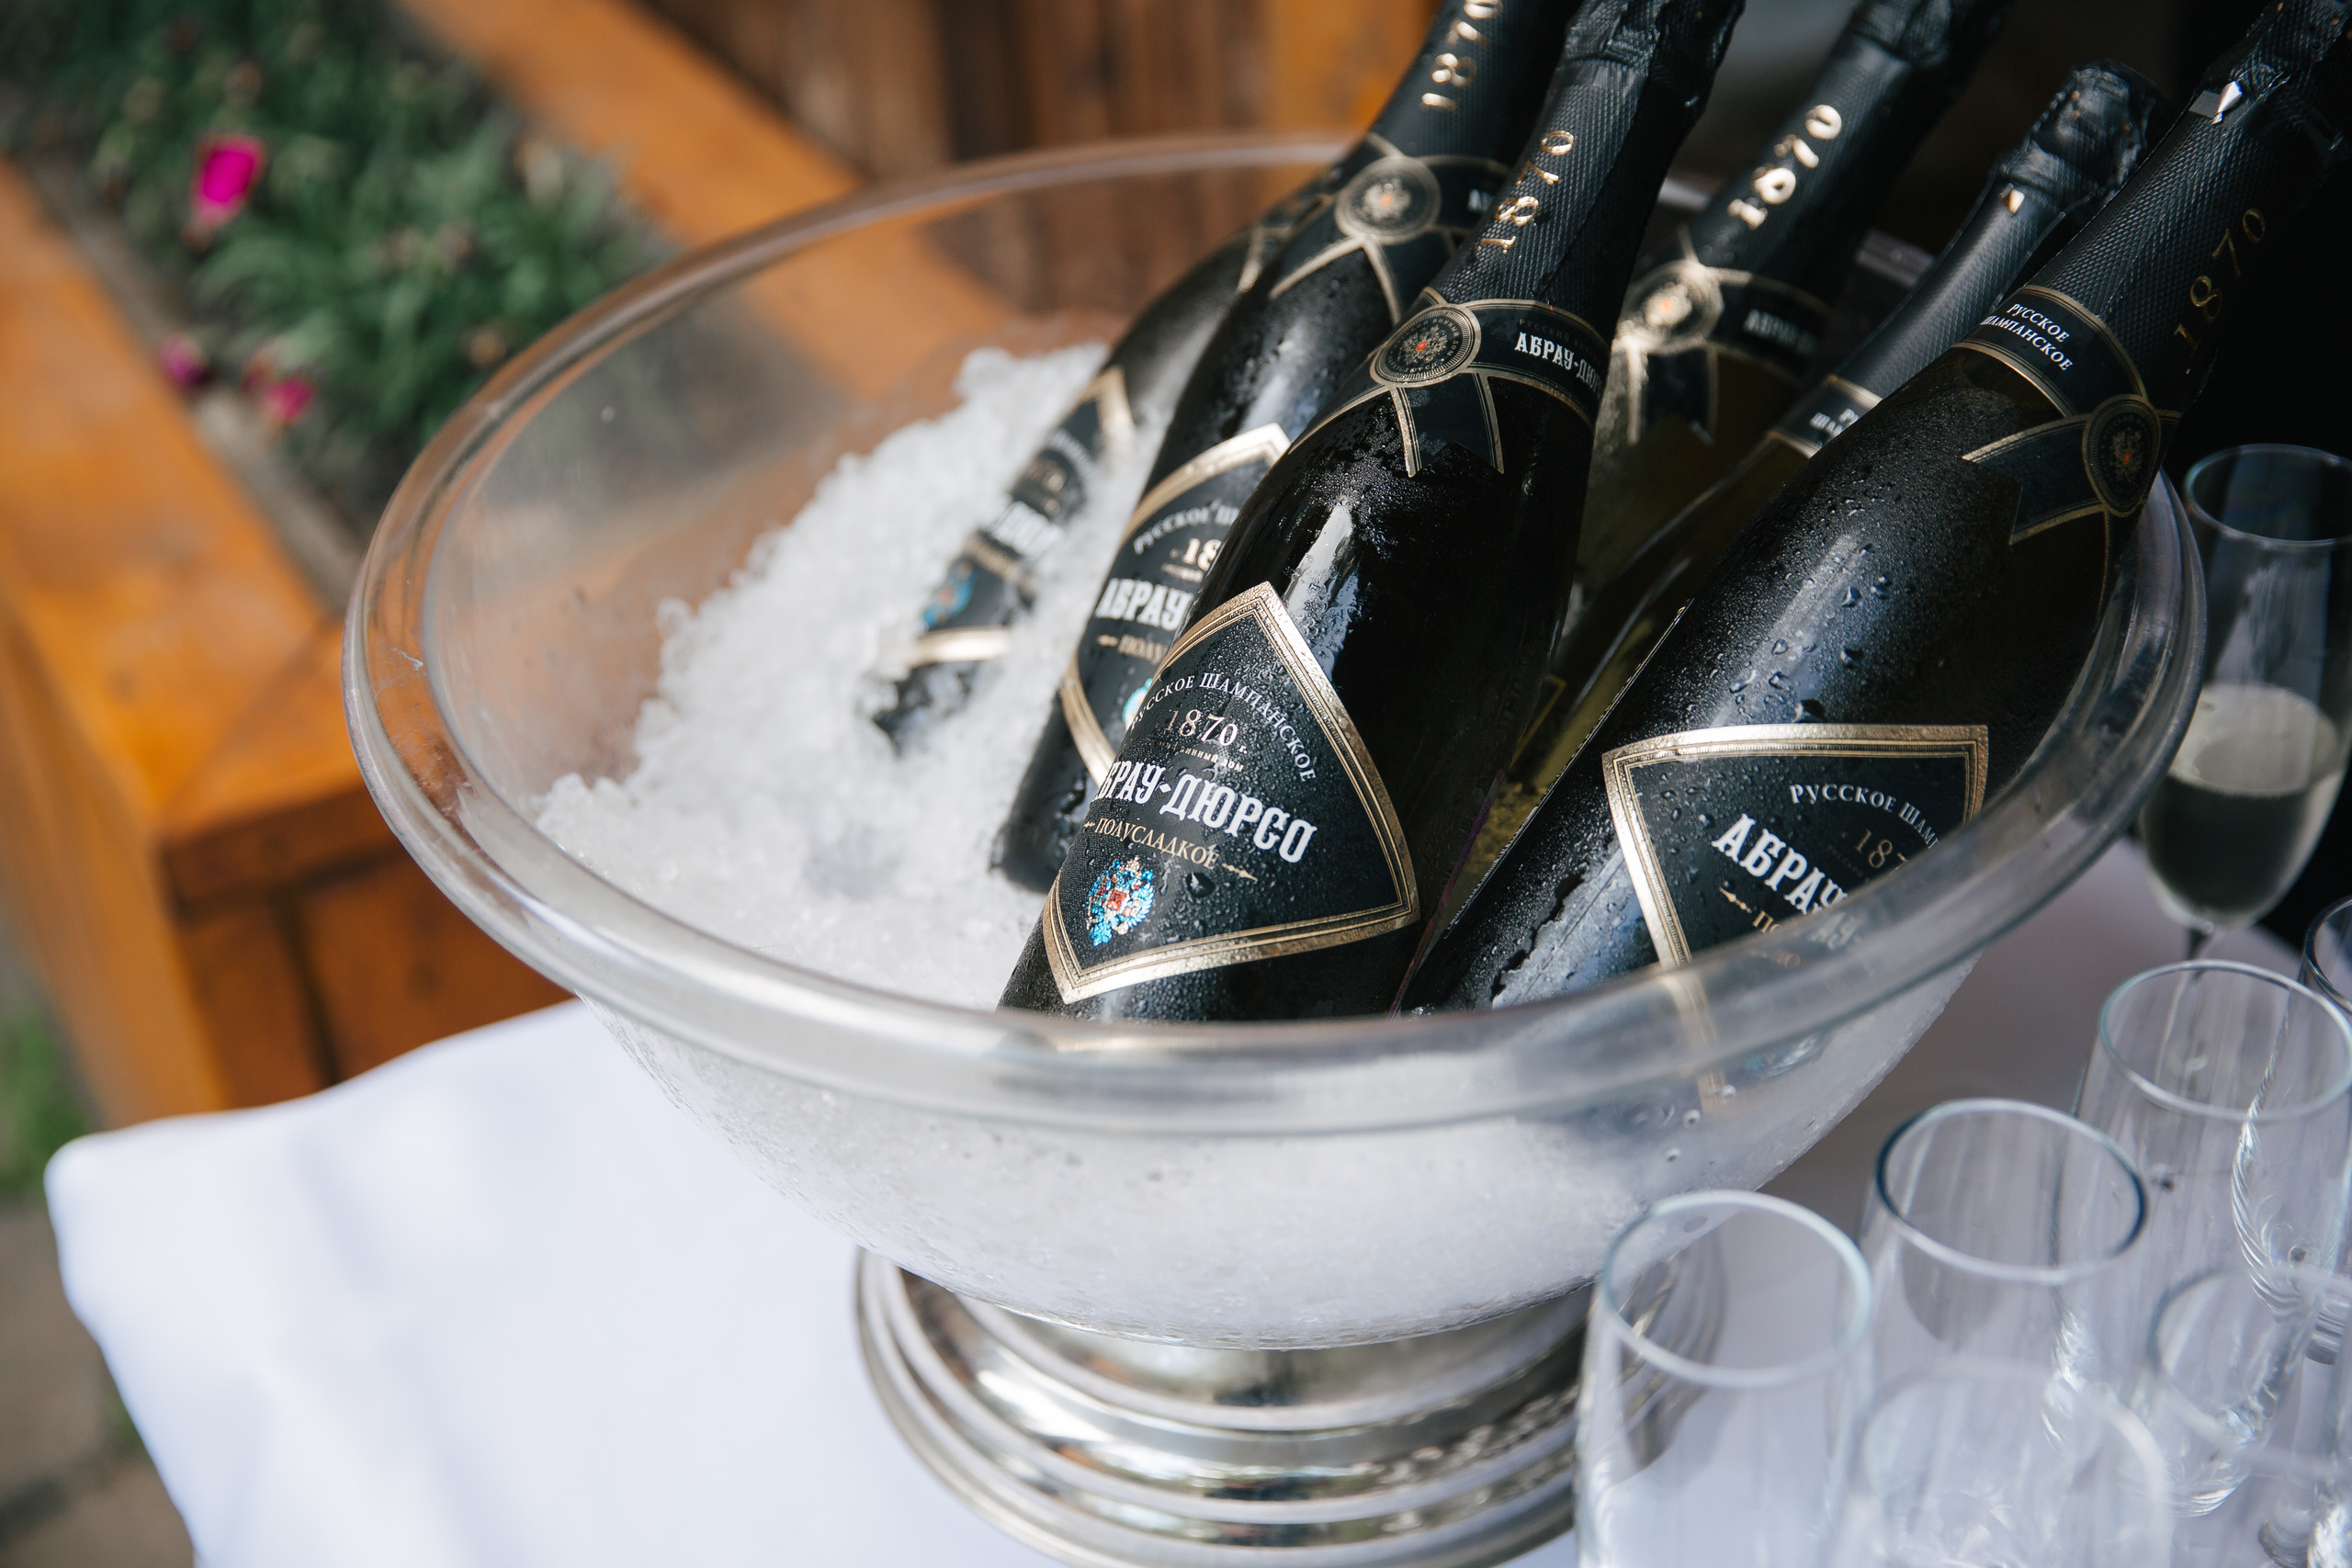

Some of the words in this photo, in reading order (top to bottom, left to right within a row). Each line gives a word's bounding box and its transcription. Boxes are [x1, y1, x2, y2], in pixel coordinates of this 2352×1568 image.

[1477, 130, 1575, 254] 1870
[2174, 209, 2266, 358] 1870
[1980, 315, 2074, 371] ШАМПАНСКОЕ
[2007, 303, 2070, 343] РУССКОЕ
[1164, 708, 1238, 747] 1870
[1199, 671, 1317, 783] ШАМПАНСКОЕ
[1789, 783, 1896, 813] РУССКОЕ
[1094, 818, 1219, 872] ПОЛУСЛАДКОЕ
